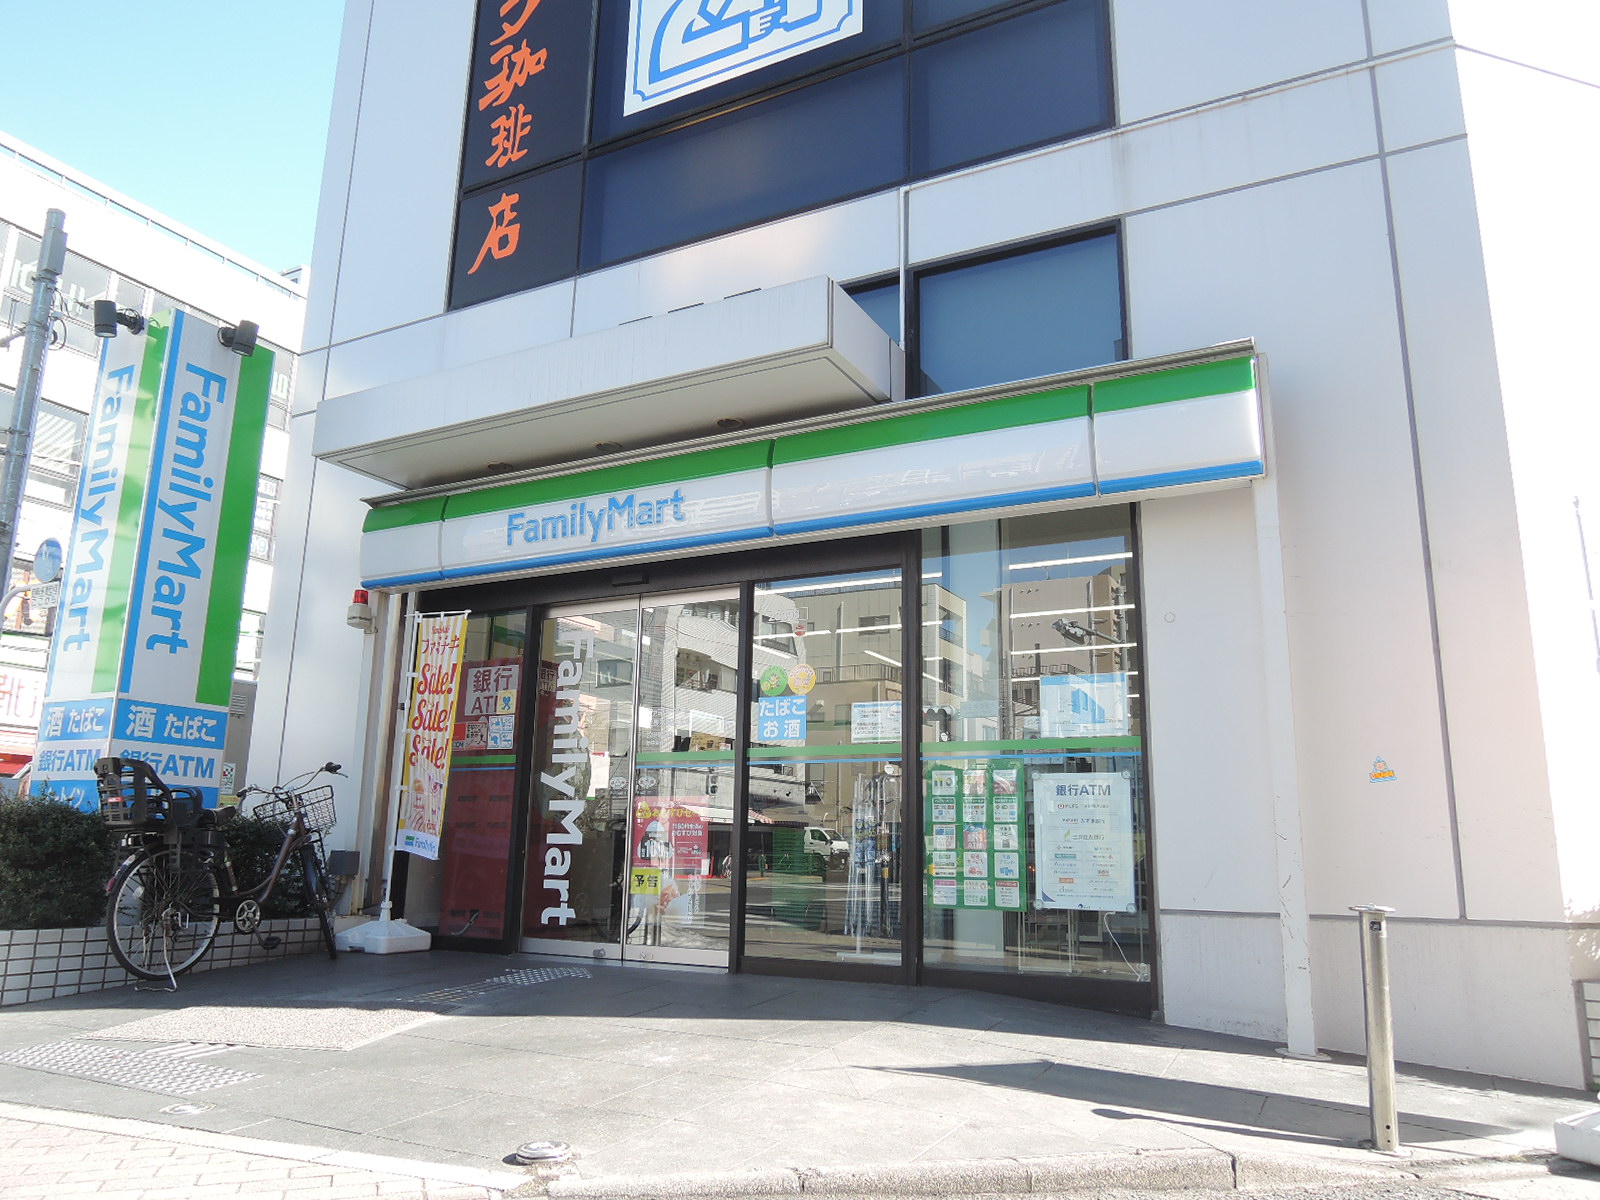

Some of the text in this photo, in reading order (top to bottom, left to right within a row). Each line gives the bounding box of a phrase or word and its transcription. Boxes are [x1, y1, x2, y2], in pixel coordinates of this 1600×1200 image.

[62, 363, 136, 654] FamilyMart
[144, 361, 228, 655] FamilyMart
[506, 487, 686, 546] FamilyMart
[416, 663, 458, 696] Sale!
[472, 667, 513, 694] 銀行
[411, 698, 454, 733] Sale!
[470, 695, 499, 714] AT
[759, 697, 806, 717] たばこ
[46, 706, 105, 737] 酒 たばこ
[125, 705, 217, 742] 酒 たばこ
[38, 749, 101, 772] 銀行ATM
[540, 630, 595, 927] FamilyMart
[1055, 784, 1111, 797] 銀行ATM
[634, 873, 660, 889] 予告
